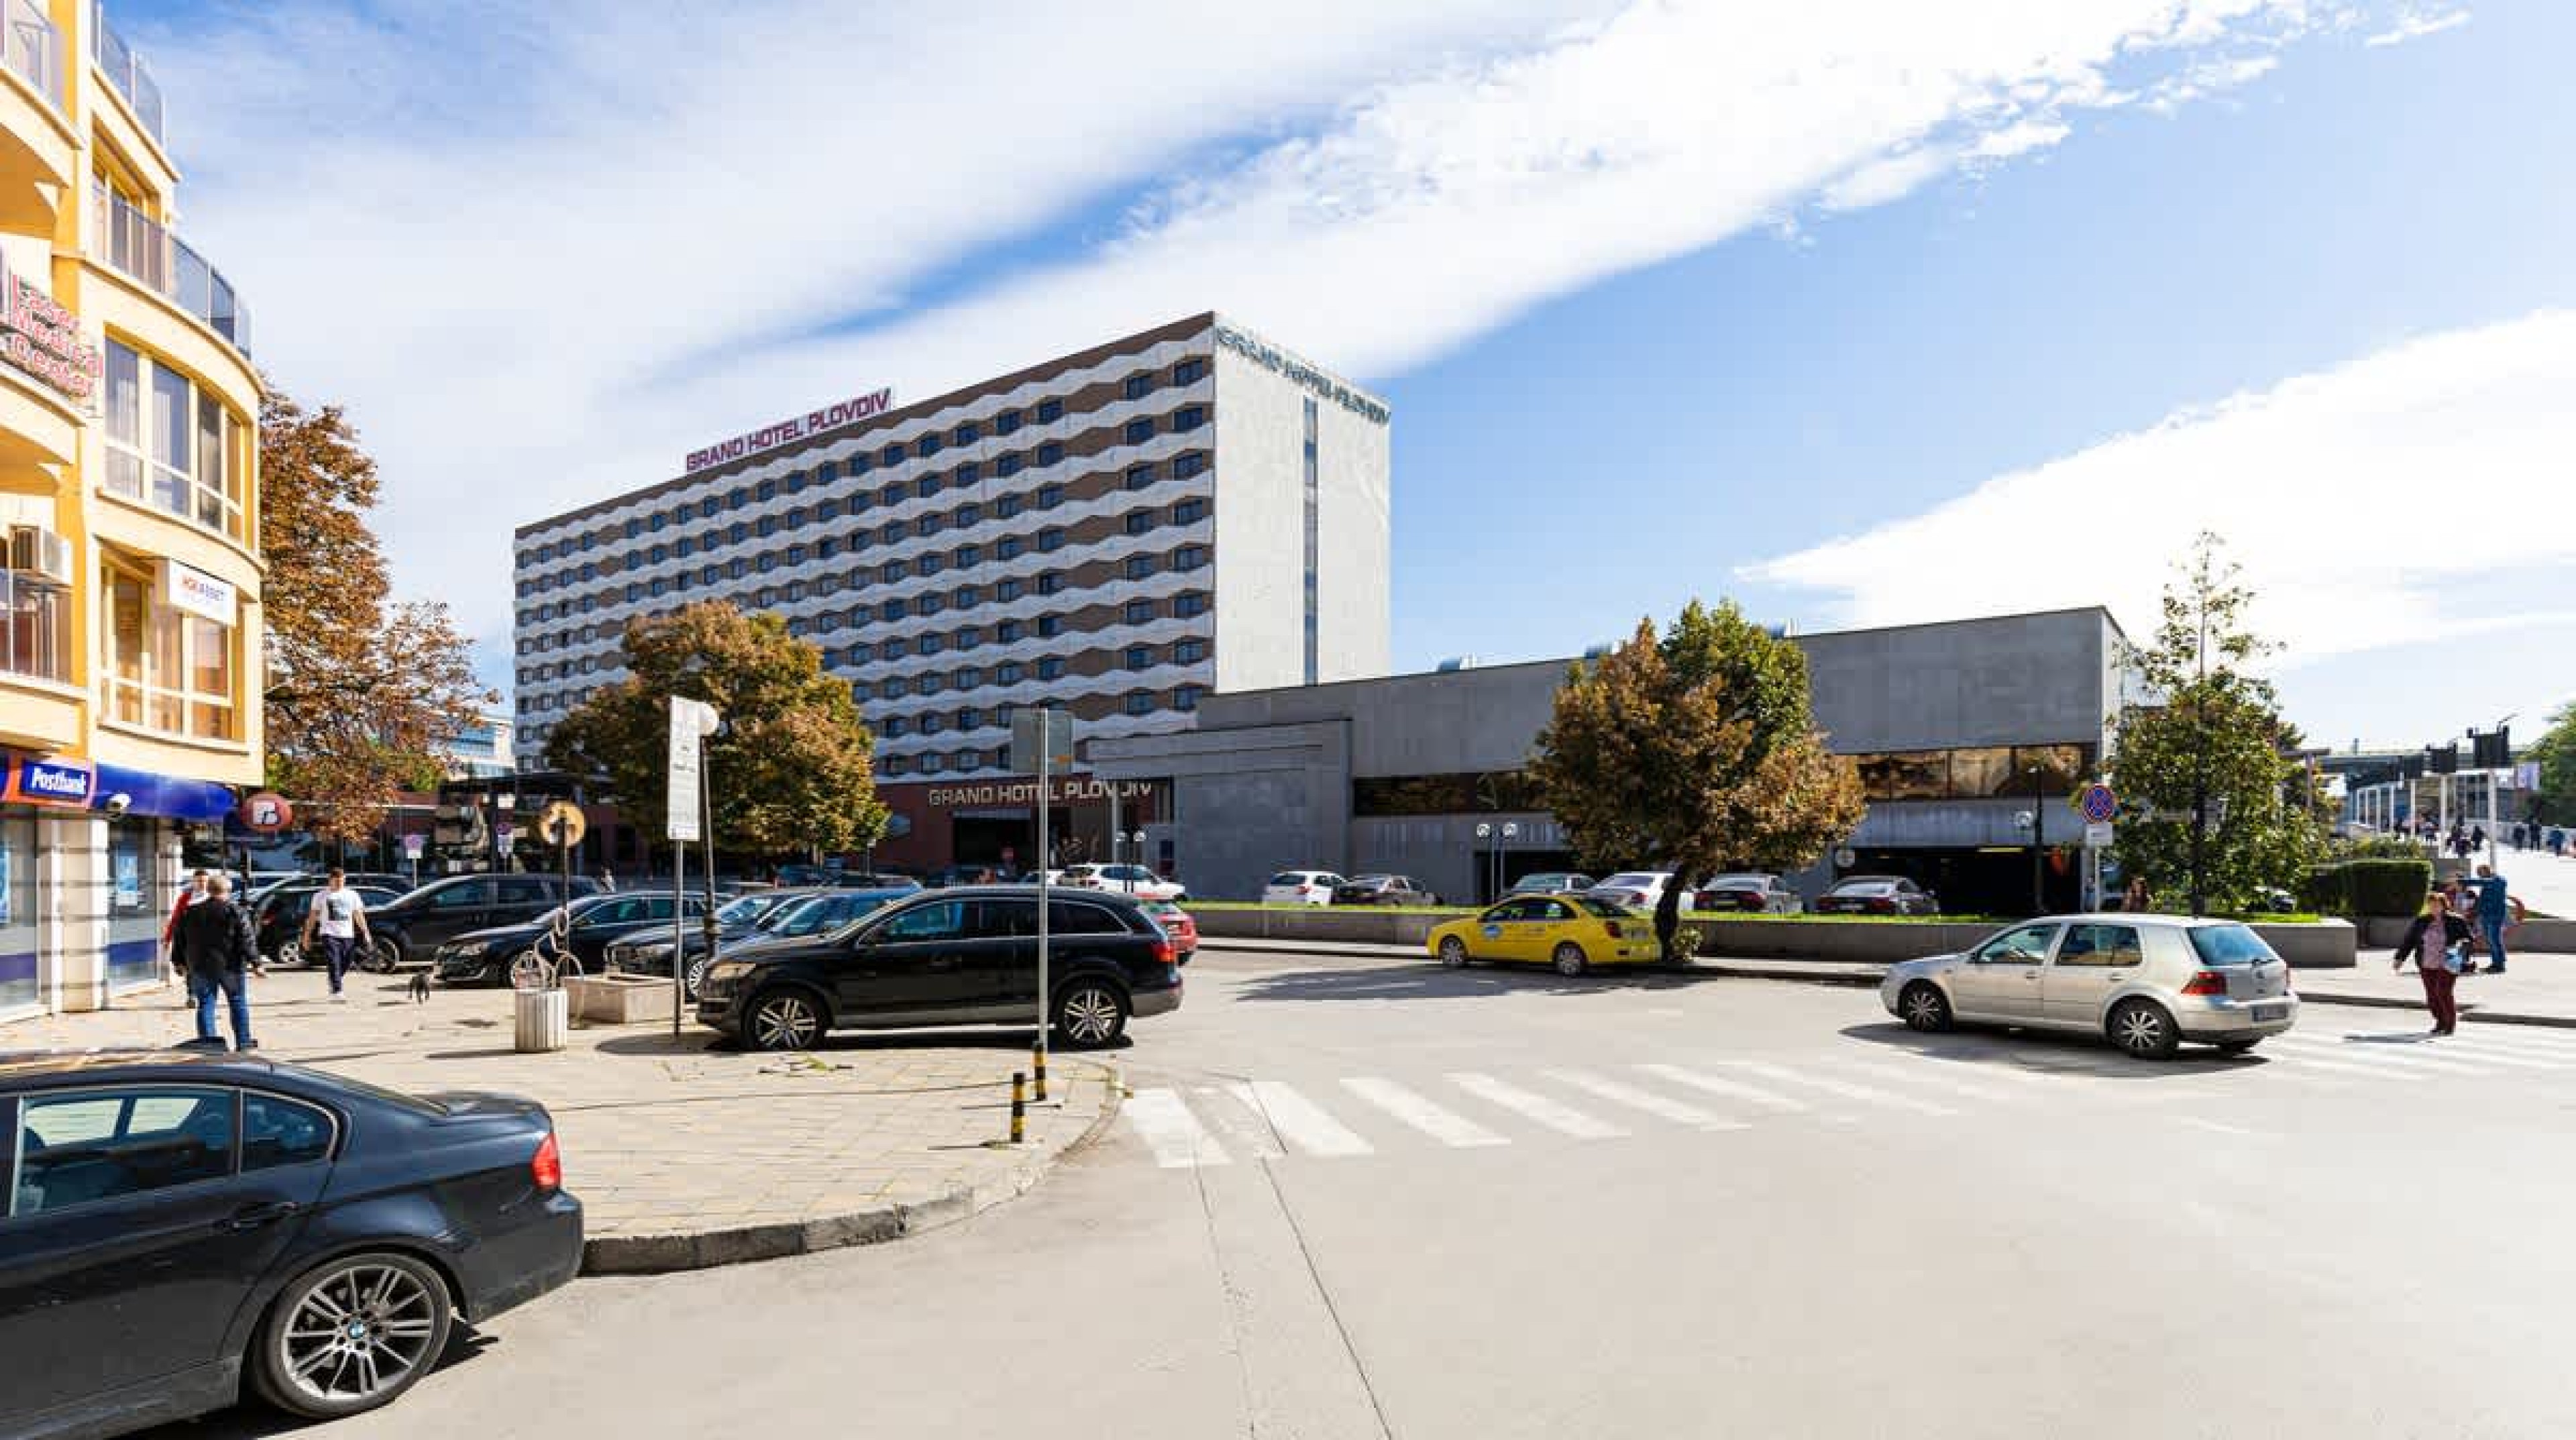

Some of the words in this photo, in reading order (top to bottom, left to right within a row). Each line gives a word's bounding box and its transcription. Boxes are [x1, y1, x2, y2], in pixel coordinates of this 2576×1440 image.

[686, 437, 743, 470] GRAND
[749, 419, 804, 451] HOTEL
[808, 387, 892, 433] PLOVDIV
[32, 766, 87, 795] Postbank
[928, 786, 993, 806] GRAND
